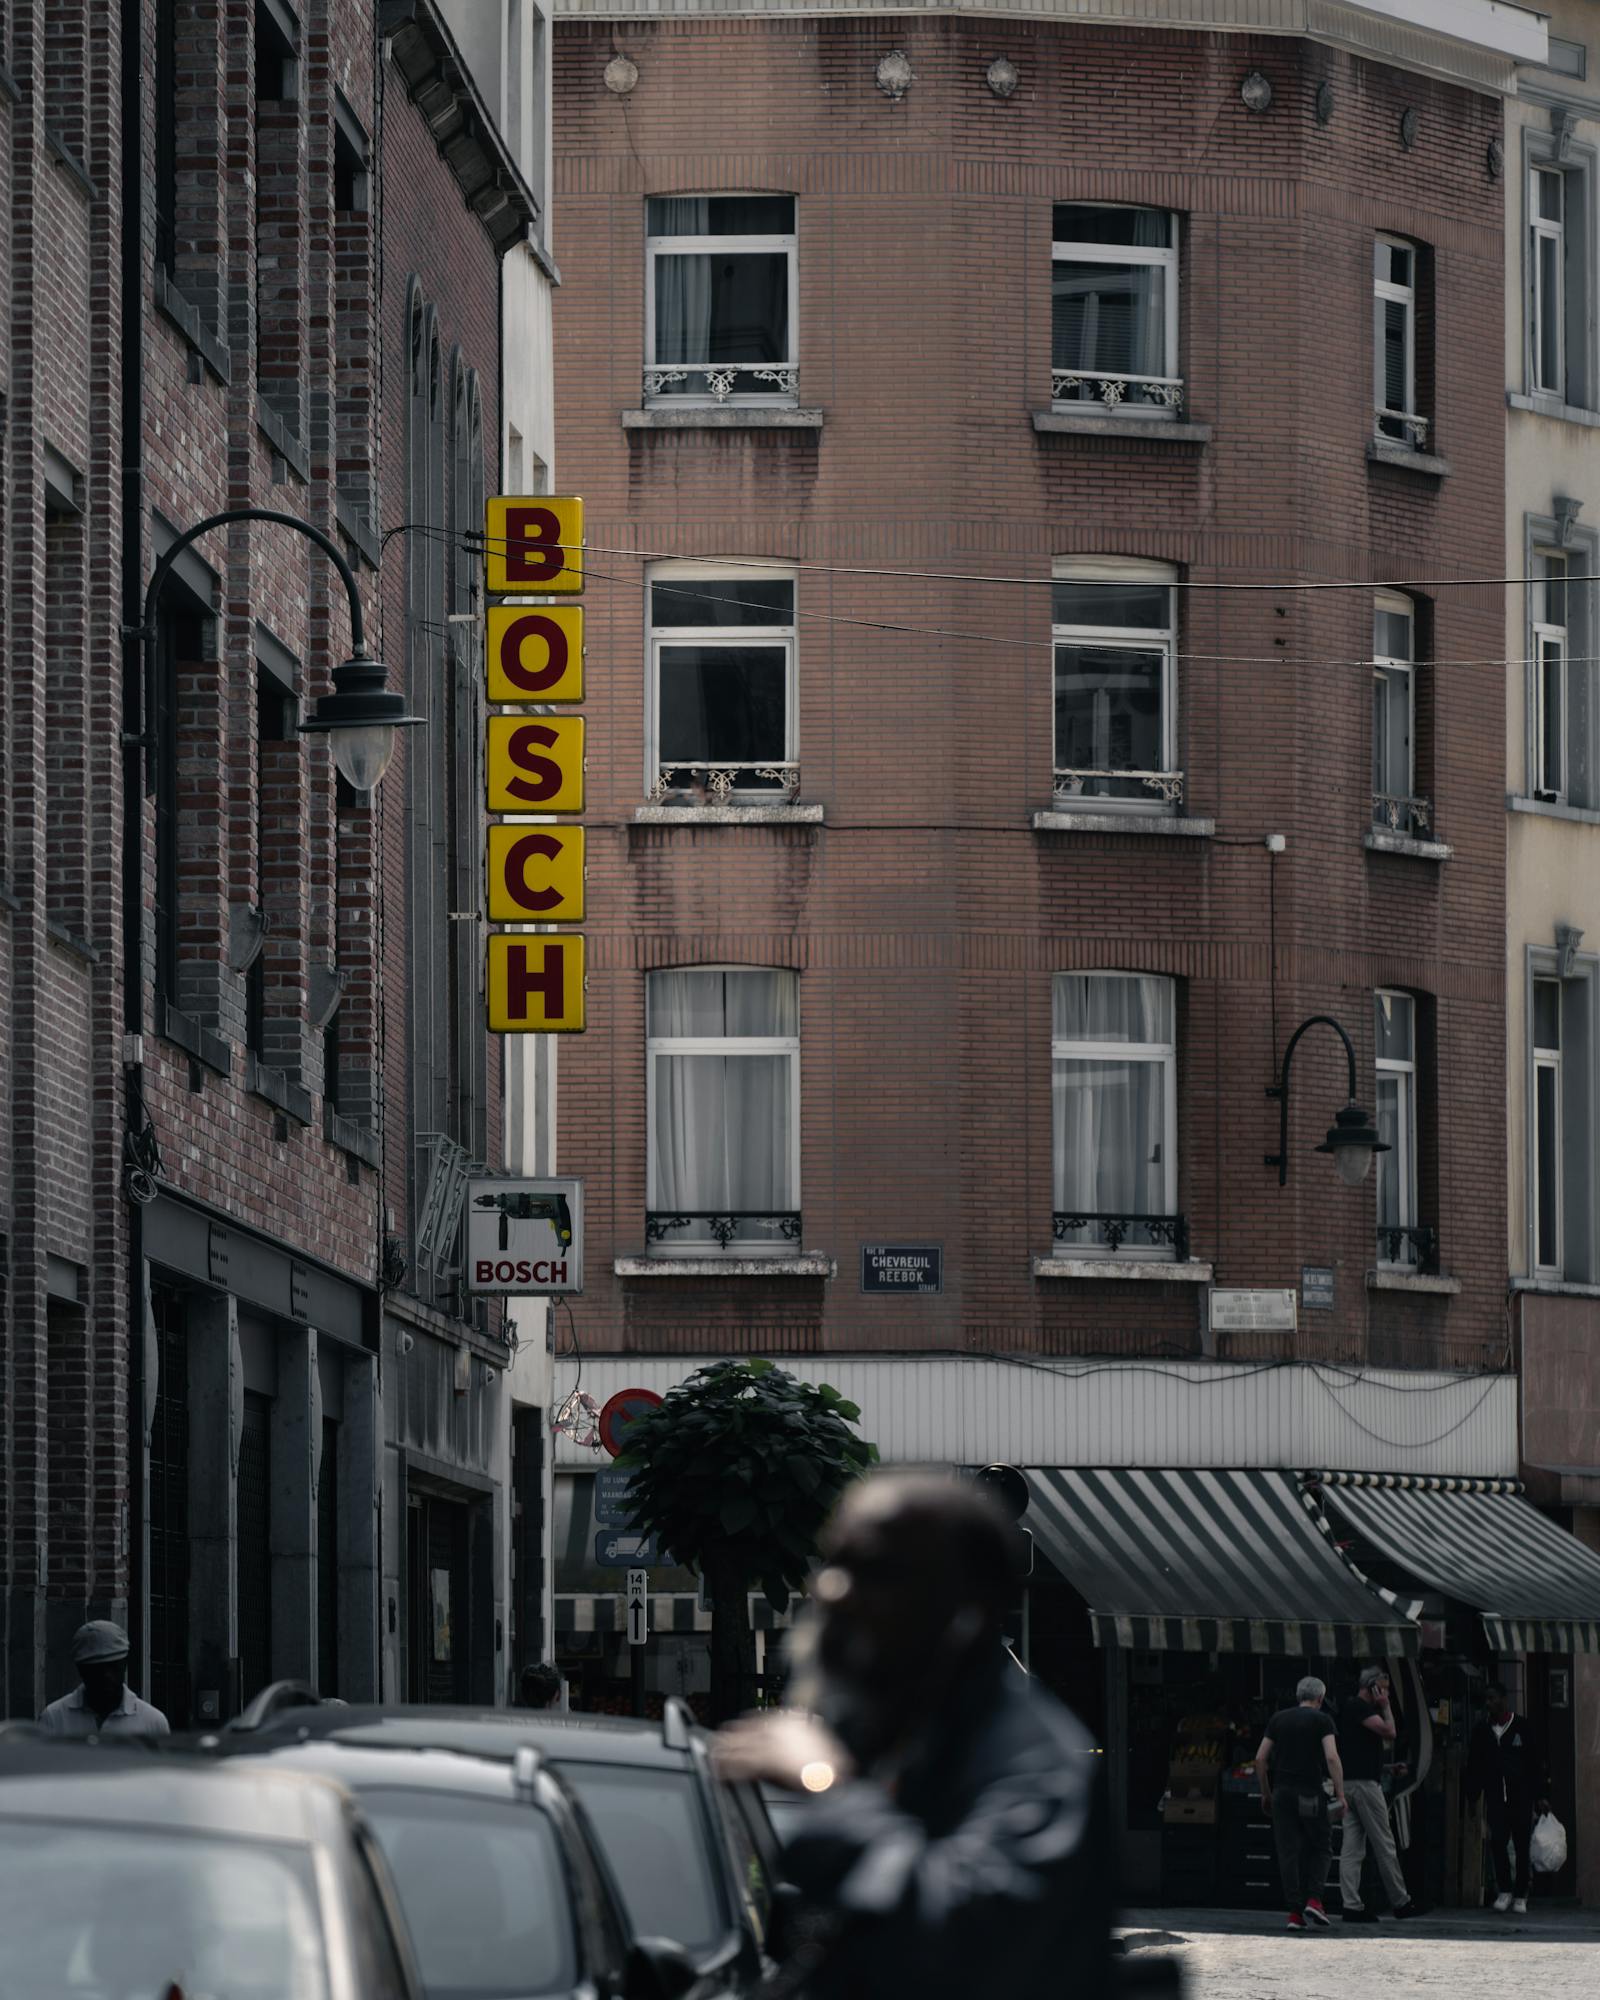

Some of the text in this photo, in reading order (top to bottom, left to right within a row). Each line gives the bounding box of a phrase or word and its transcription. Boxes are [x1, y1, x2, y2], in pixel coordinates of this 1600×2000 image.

[500, 507, 569, 1020] BOSCH
[872, 1256, 931, 1268] CHEVREUIL
[476, 1260, 567, 1283] BOSCH
[879, 1271, 924, 1283] REEBOK
[630, 1573, 643, 1585] 14
[631, 1586, 642, 1595] m
